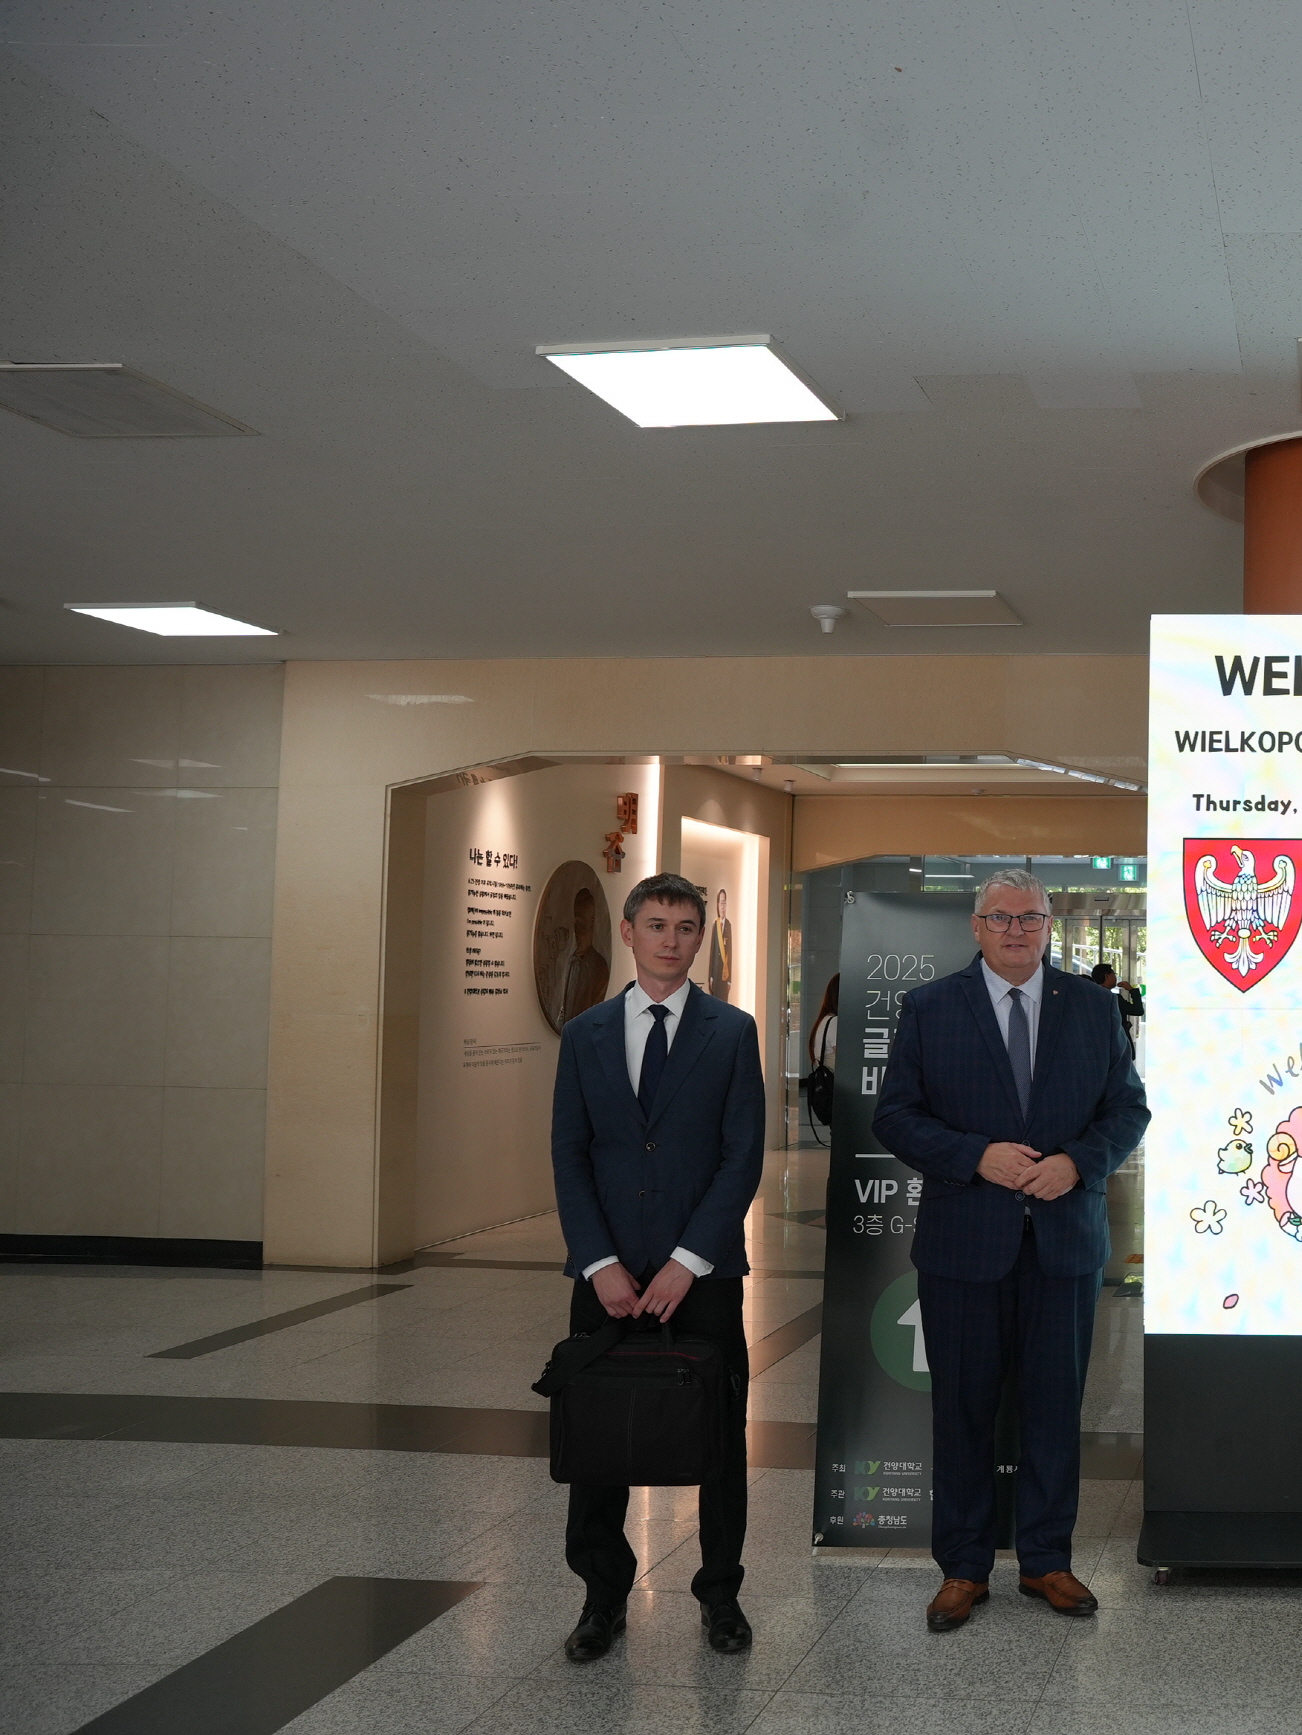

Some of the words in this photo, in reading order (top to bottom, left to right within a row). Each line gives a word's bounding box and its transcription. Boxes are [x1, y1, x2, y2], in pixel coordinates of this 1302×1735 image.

[1192, 794, 1298, 816] Thursday,
[469, 847, 484, 866] 나는
[494, 852, 501, 868] 수
[866, 953, 935, 981] 2025
[854, 1179, 899, 1204] VIP
[852, 1213, 884, 1236] 3층
[831, 1463, 846, 1473] 주최
[883, 1461, 923, 1471] 건양대학교
[830, 1489, 845, 1499] 주관
[882, 1487, 921, 1497] 건양대학교
[829, 1515, 844, 1525] 후원
[877, 1515, 907, 1525] 충청남도
